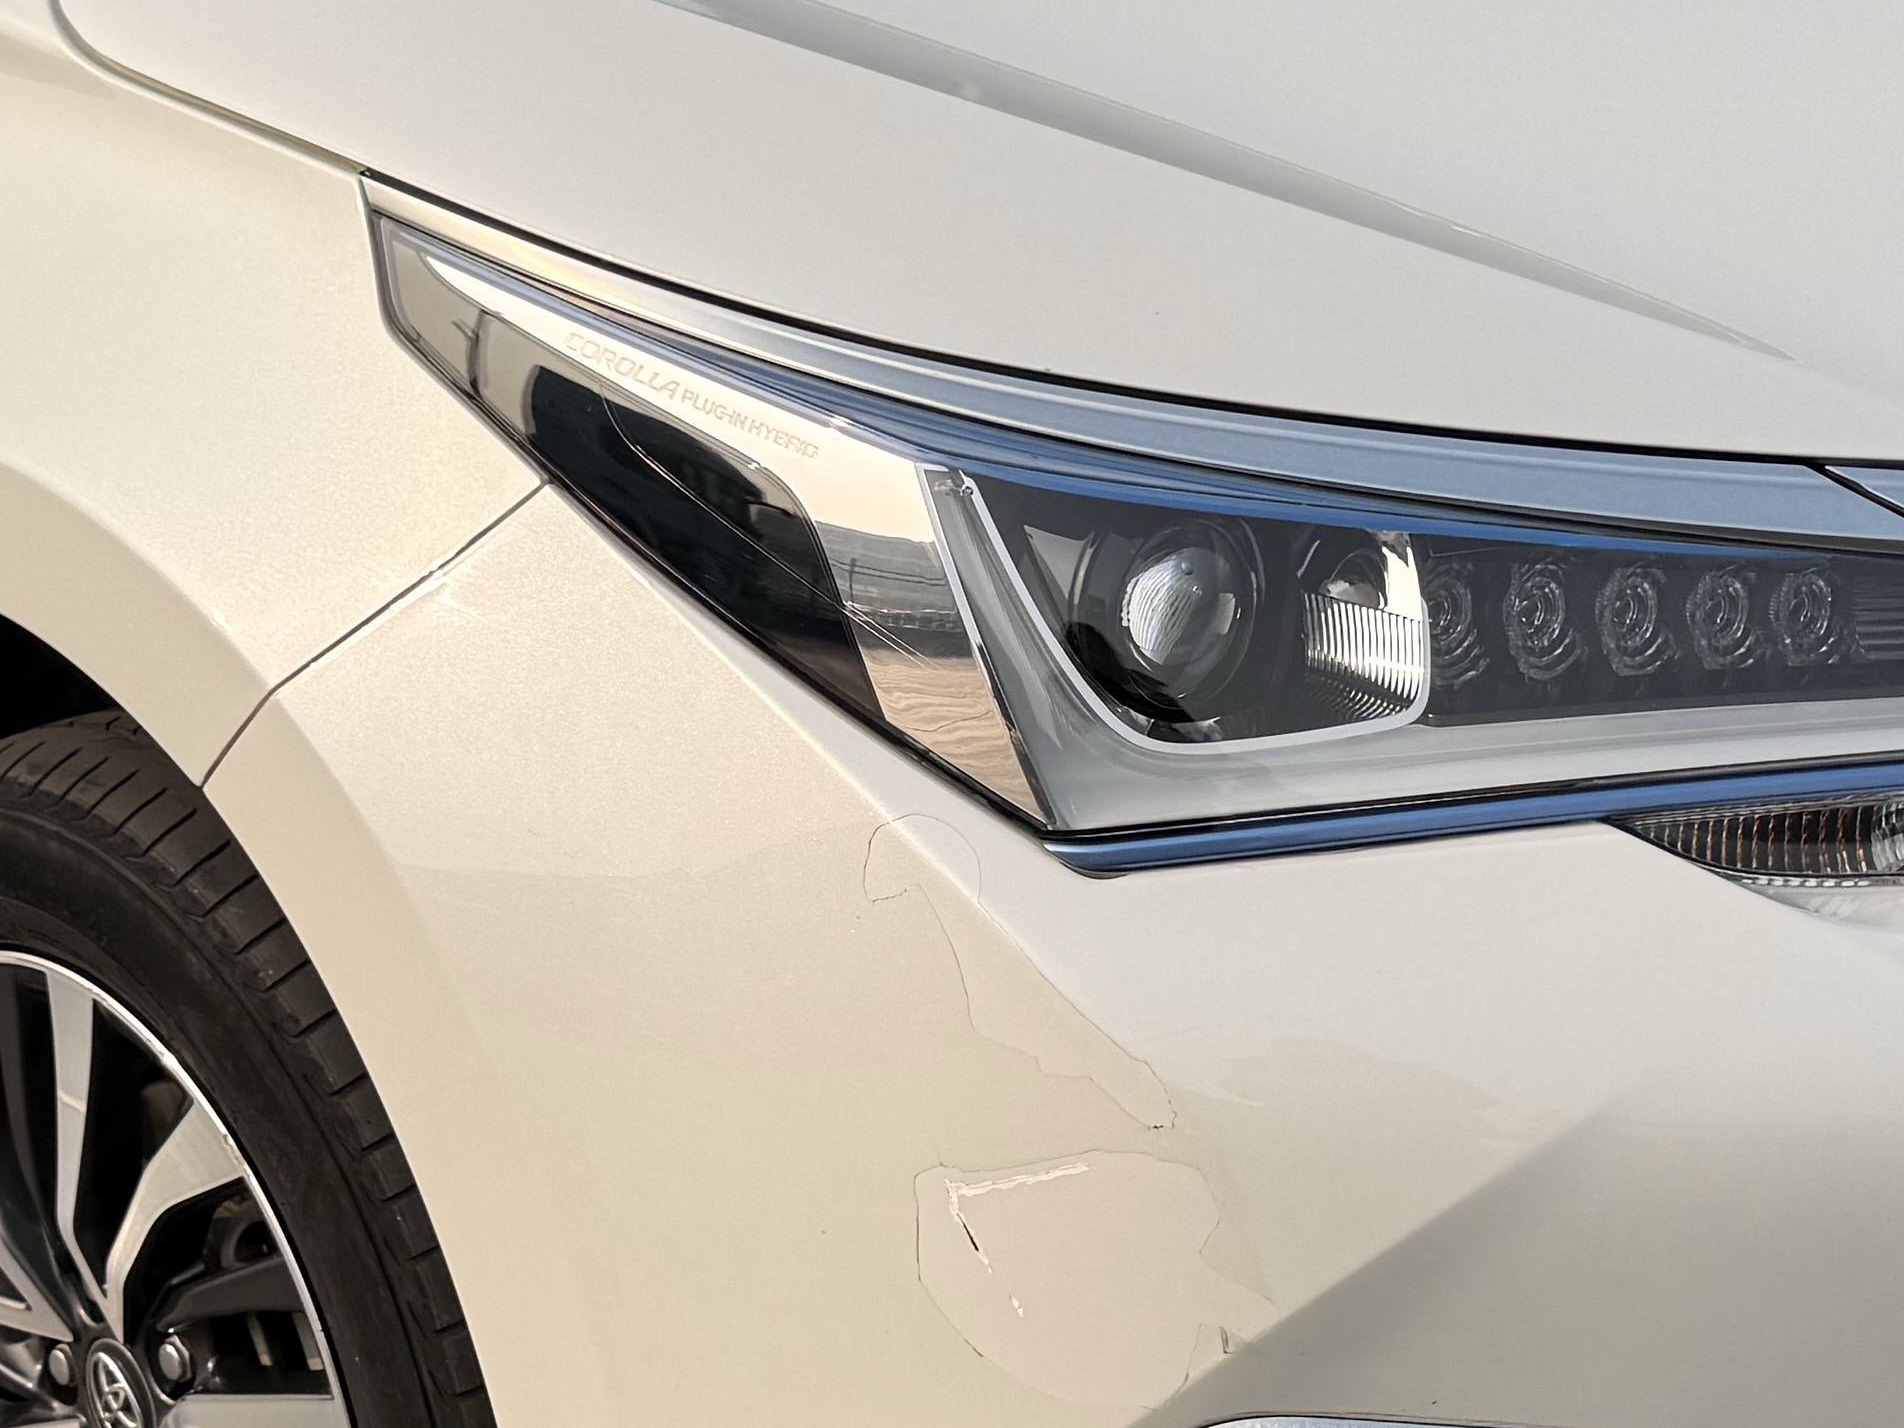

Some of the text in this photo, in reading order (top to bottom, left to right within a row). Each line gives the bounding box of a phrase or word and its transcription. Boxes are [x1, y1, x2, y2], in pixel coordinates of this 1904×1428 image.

[565, 332, 820, 459] COROLLA PLUG-IN HYBRID
